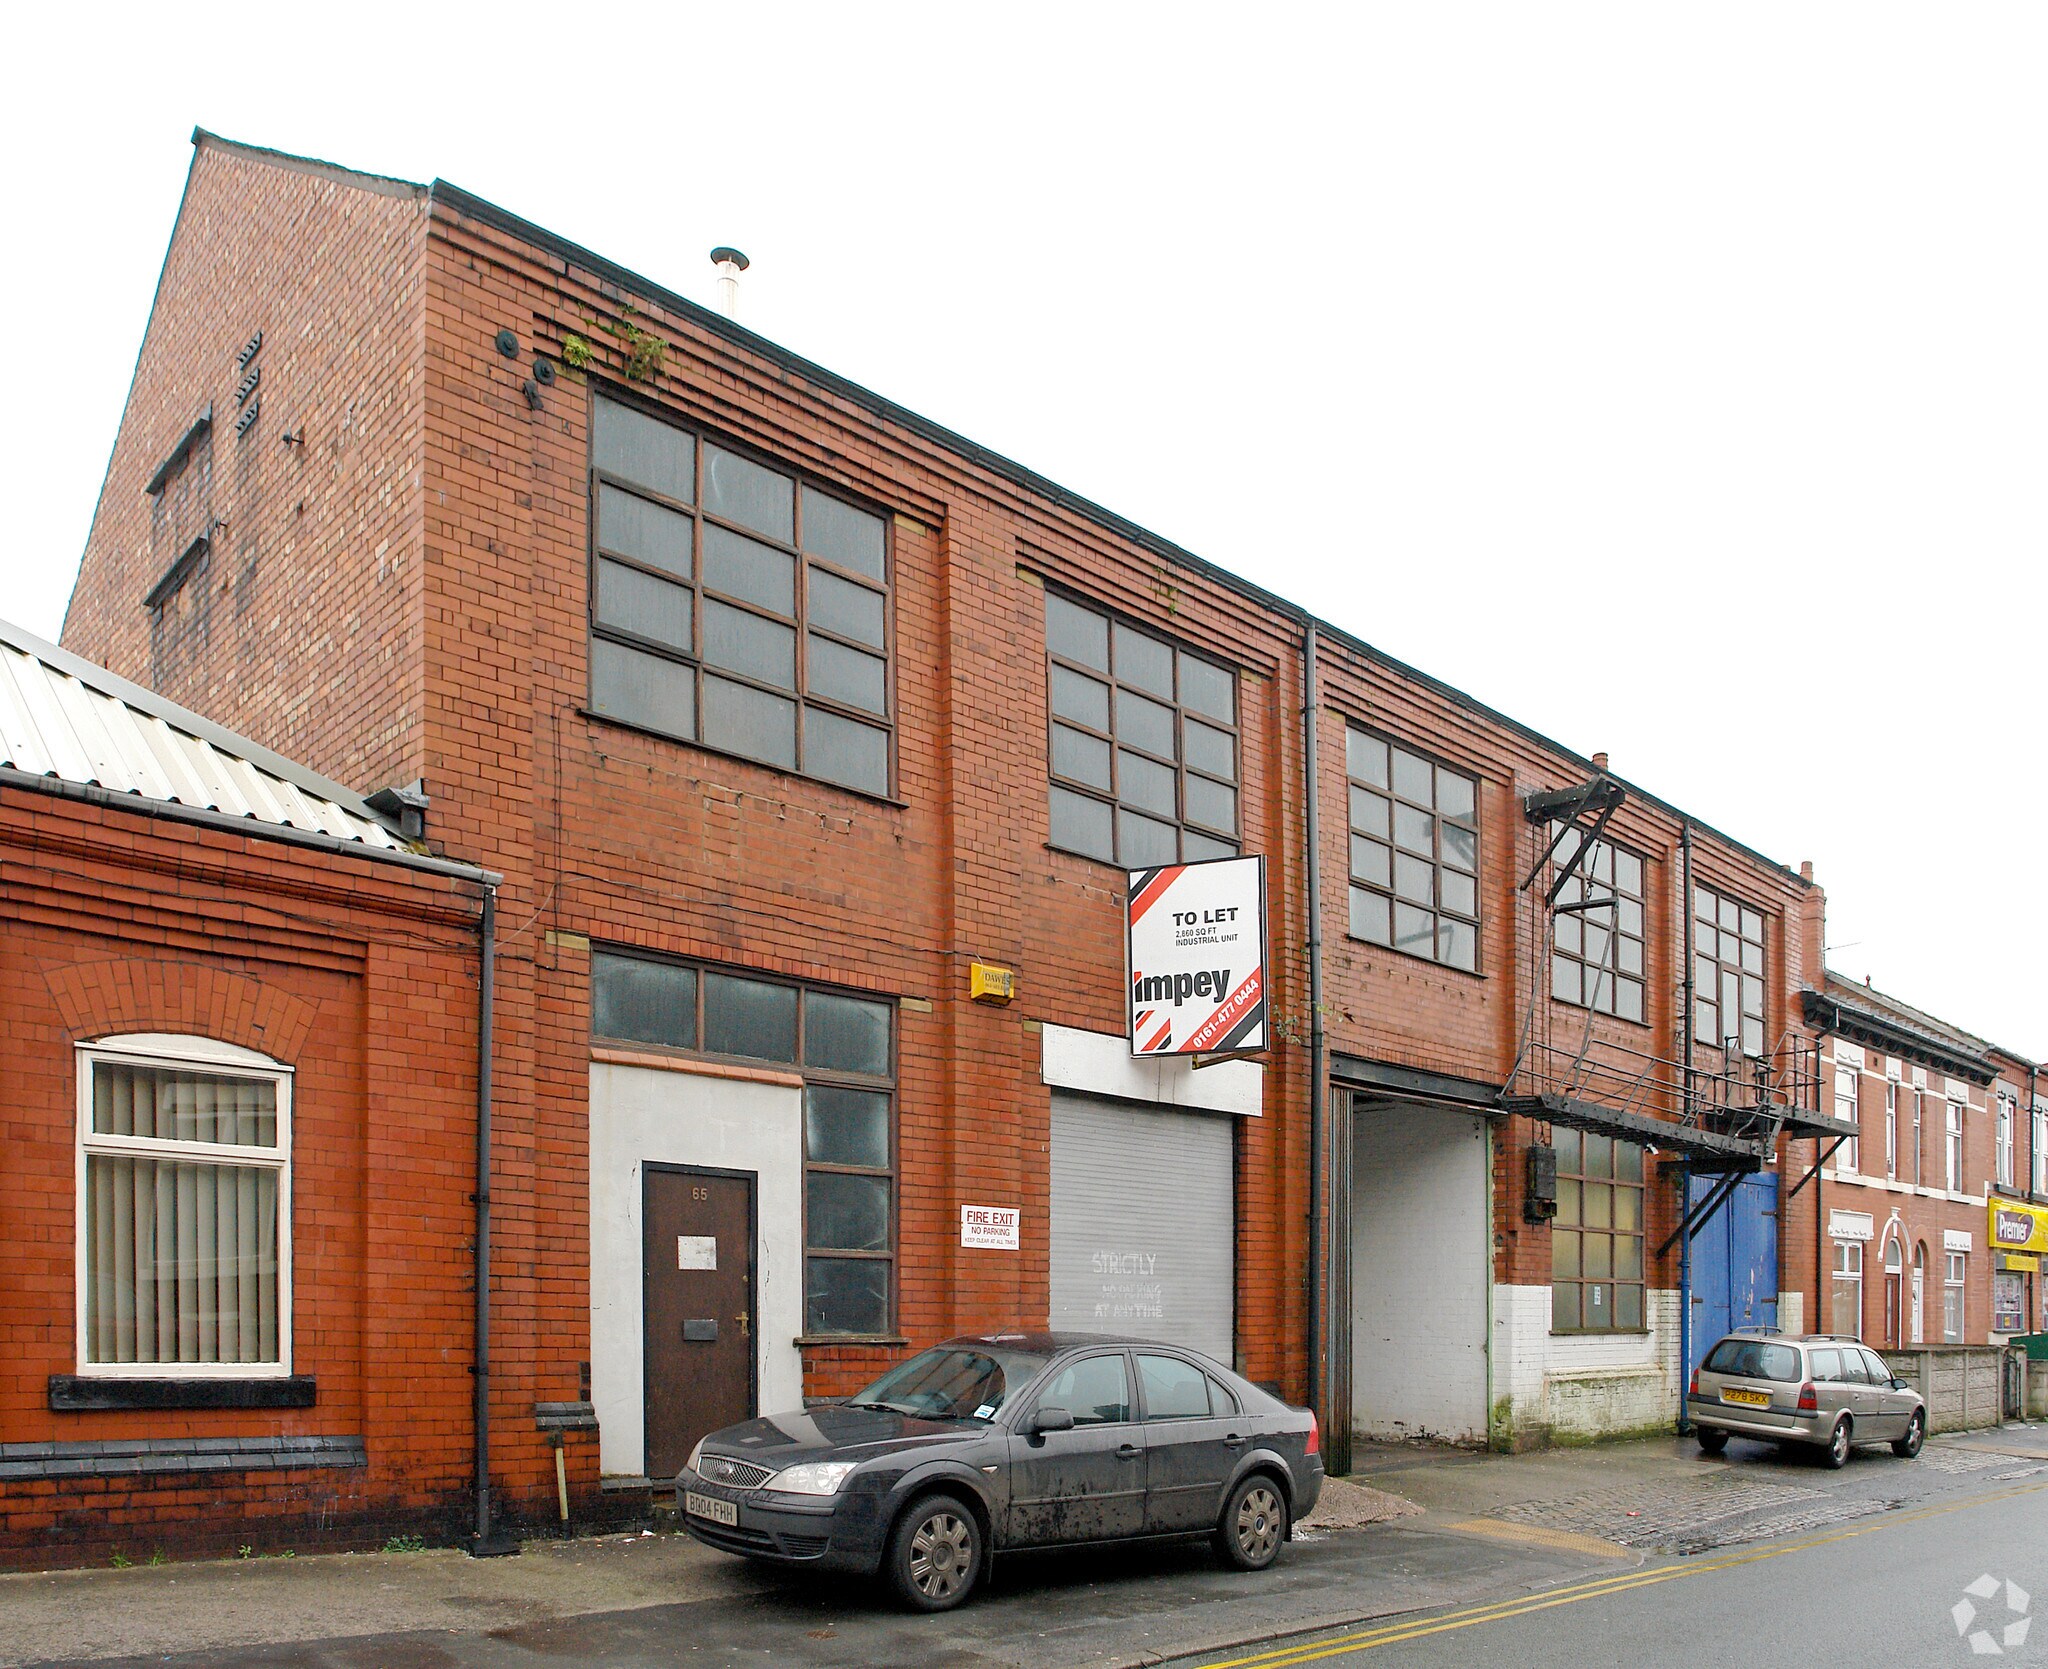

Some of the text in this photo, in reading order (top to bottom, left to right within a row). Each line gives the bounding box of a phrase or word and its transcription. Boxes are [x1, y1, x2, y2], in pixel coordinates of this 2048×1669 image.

[1172, 907, 1239, 926] TO LET
[1175, 926, 1217, 938] 2,860 SQ FT
[1175, 933, 1239, 947] INDUSTRIAL UNIT
[1133, 969, 1231, 1007] impey
[1193, 1001, 1235, 1048] 0161-477
[1234, 979, 1259, 1006] 0444
[692, 1187, 708, 1201] 65
[967, 1210, 1014, 1224] FIRE EXIT
[971, 1226, 1010, 1236] NO PARKING
[1999, 1213, 2028, 1241] Premier
[1091, 1250, 1157, 1275] STRICTLY
[1724, 1389, 1767, 1404] P278 SKX
[713, 1502, 733, 1522] FHH
